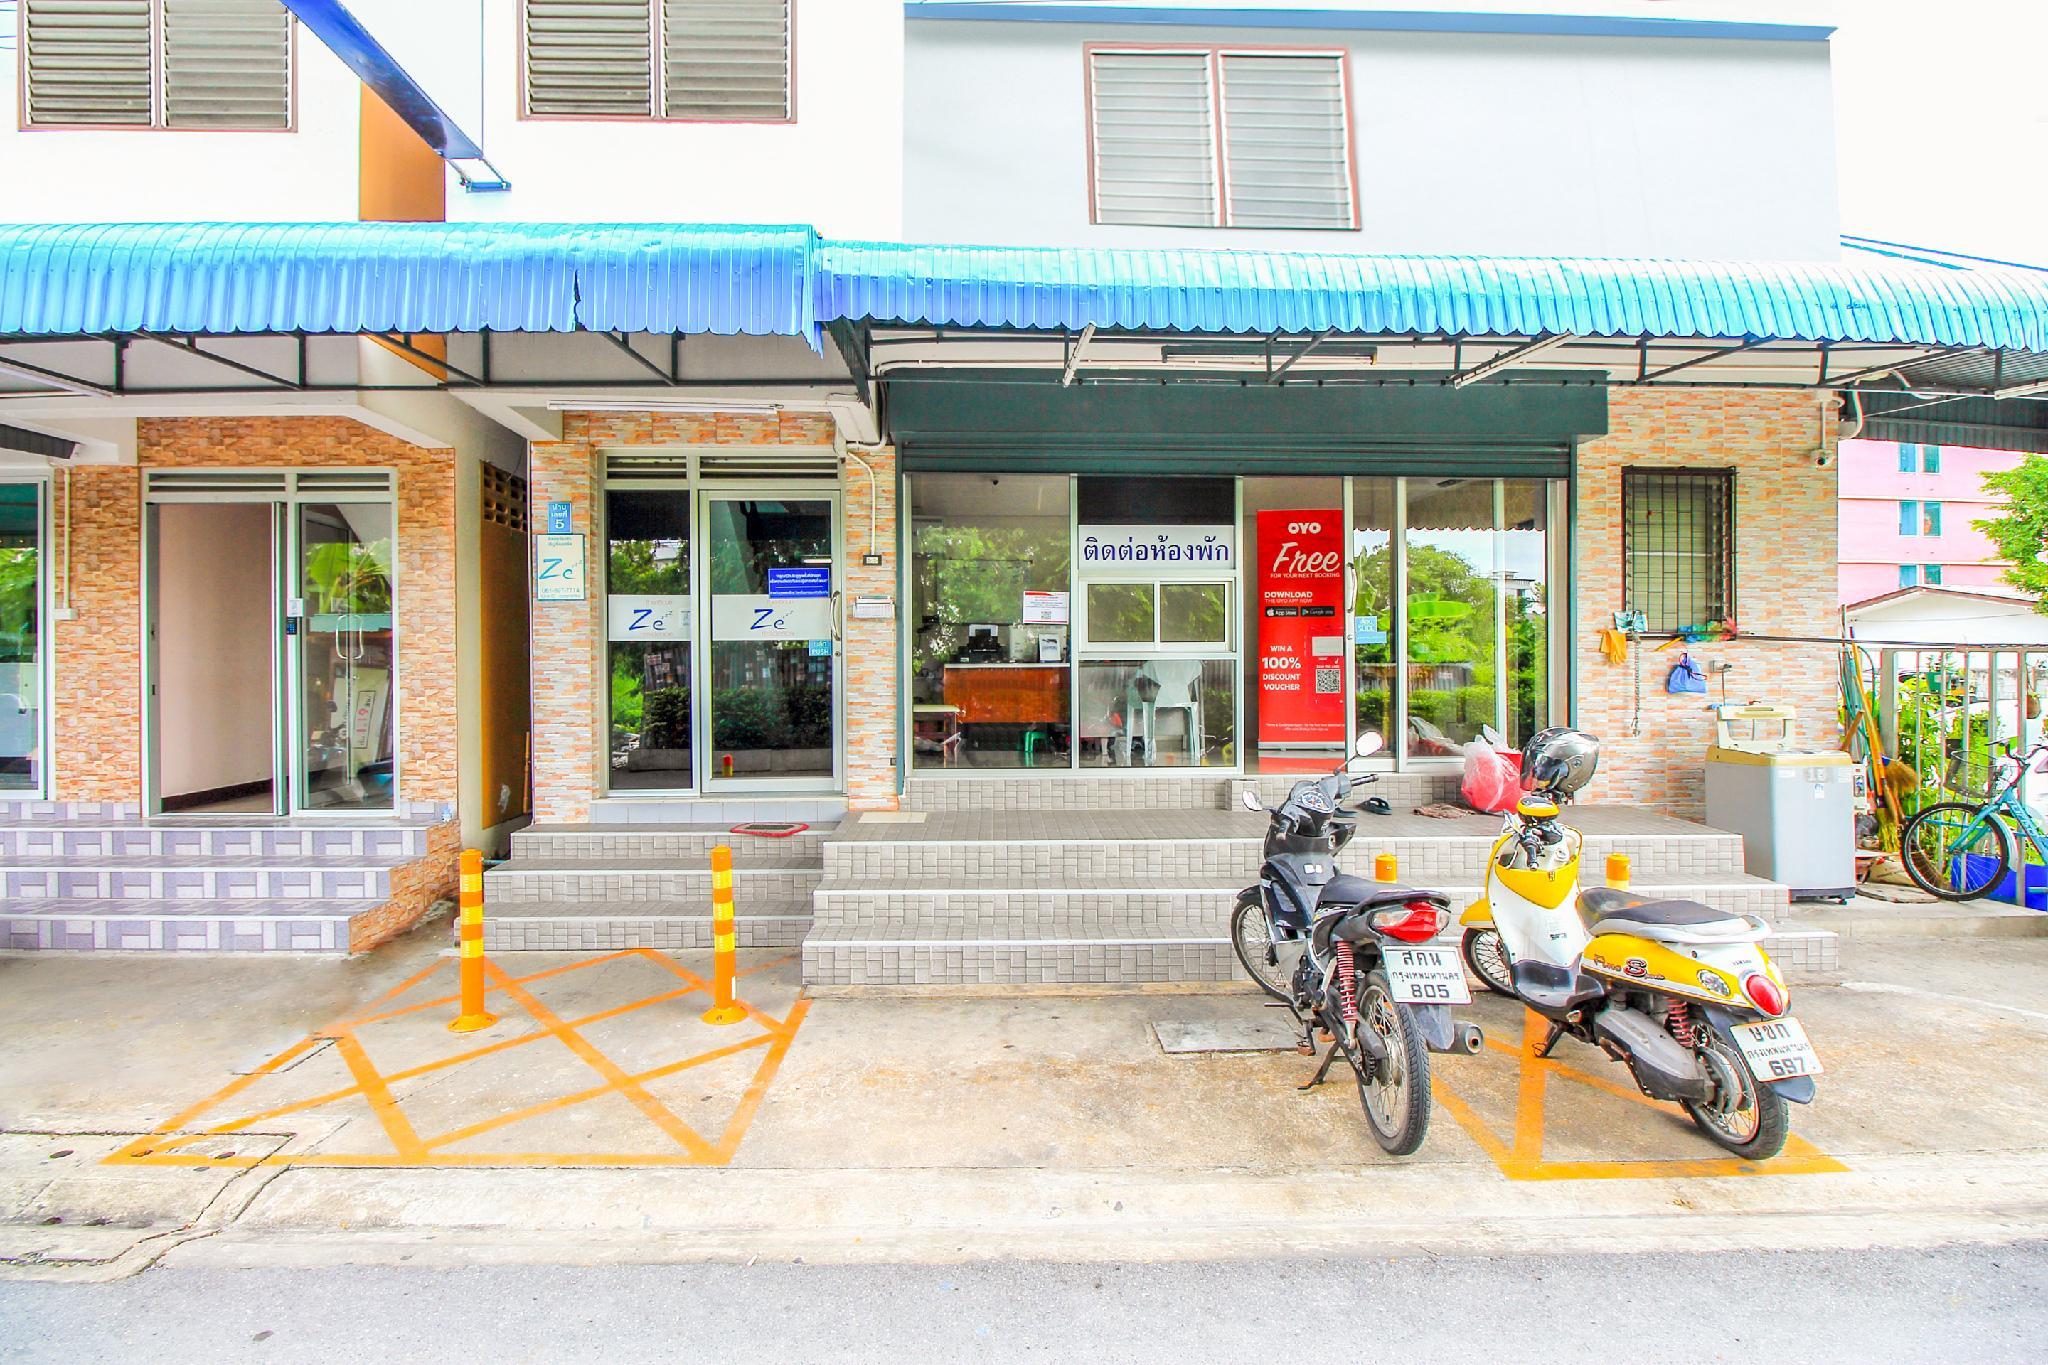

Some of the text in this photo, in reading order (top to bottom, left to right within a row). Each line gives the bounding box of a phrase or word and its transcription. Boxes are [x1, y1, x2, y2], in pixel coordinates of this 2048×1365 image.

[554, 519, 565, 529] 5
[1287, 522, 1322, 535] OYO
[1083, 534, 1229, 561] ติดต่อห้องพัก
[1272, 541, 1341, 573] Free
[1264, 591, 1313, 599] DOWNLOAD
[1261, 657, 1302, 669] 100%
[1262, 673, 1301, 681] DISCOUNT
[1263, 683, 1301, 691] VOUCHER
[1410, 984, 1450, 998] 805
[1768, 1056, 1806, 1076] 697
